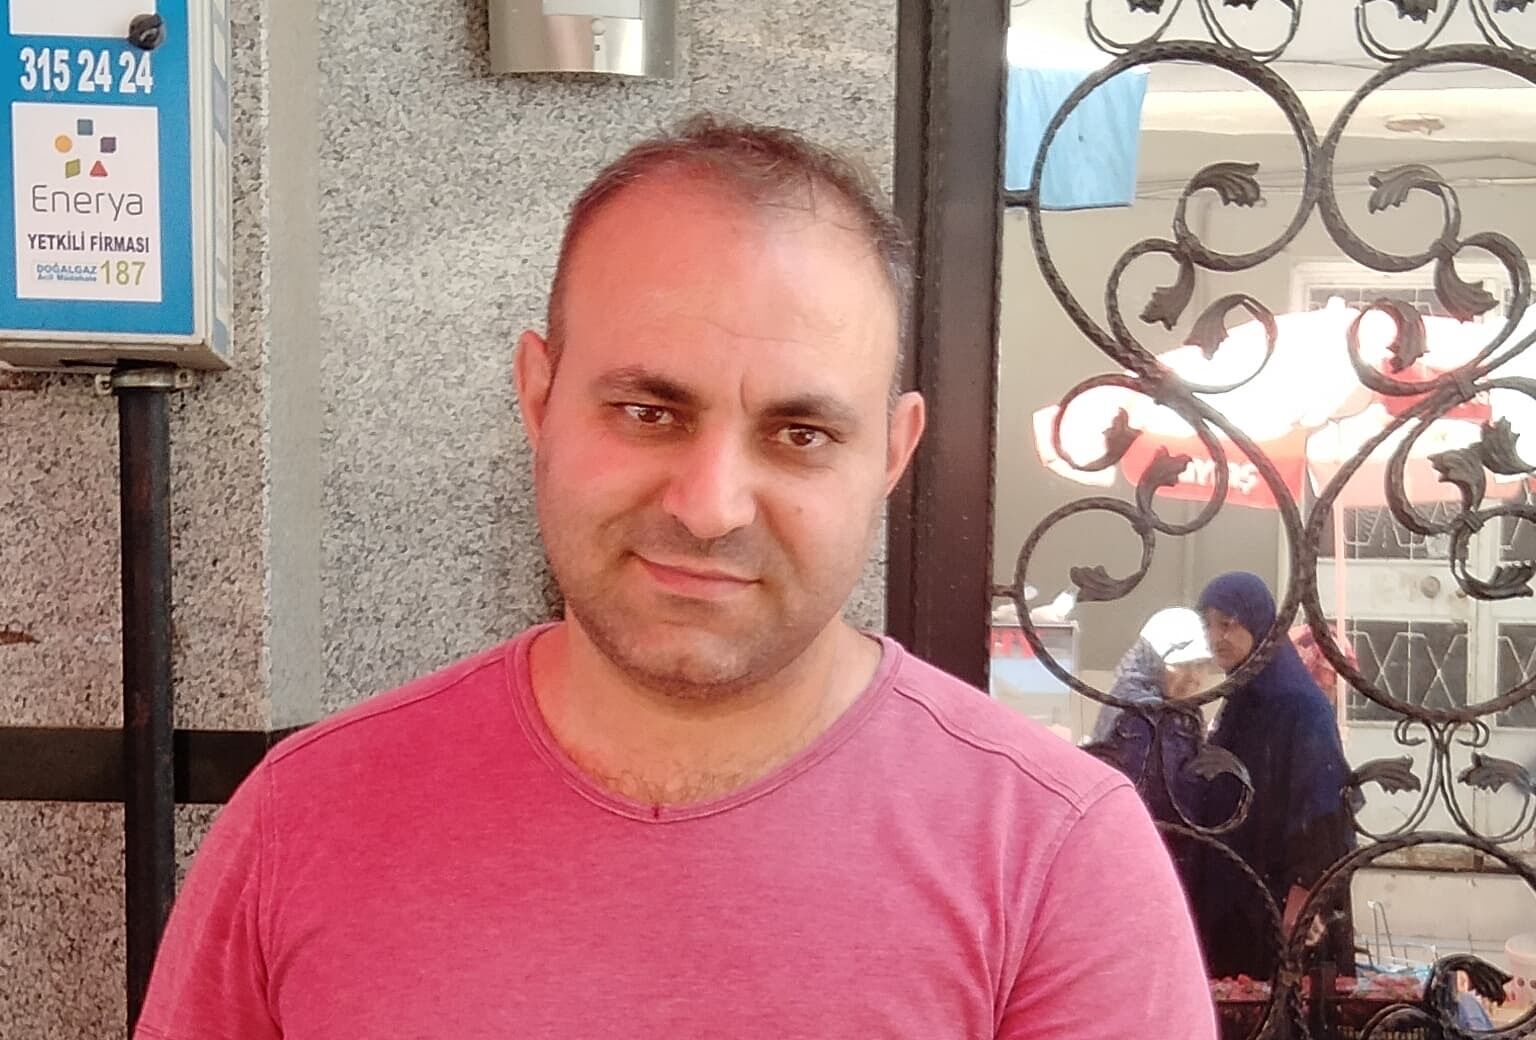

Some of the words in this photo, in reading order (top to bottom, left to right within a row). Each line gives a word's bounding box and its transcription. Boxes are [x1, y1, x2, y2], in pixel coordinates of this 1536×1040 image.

[20, 47, 70, 91] 315
[77, 49, 112, 93] 24
[119, 50, 153, 94] 24
[32, 184, 144, 222] Enerya
[28, 231, 85, 251] YETKİLİ
[90, 231, 150, 253] FİRMASI
[100, 260, 146, 286] 187
